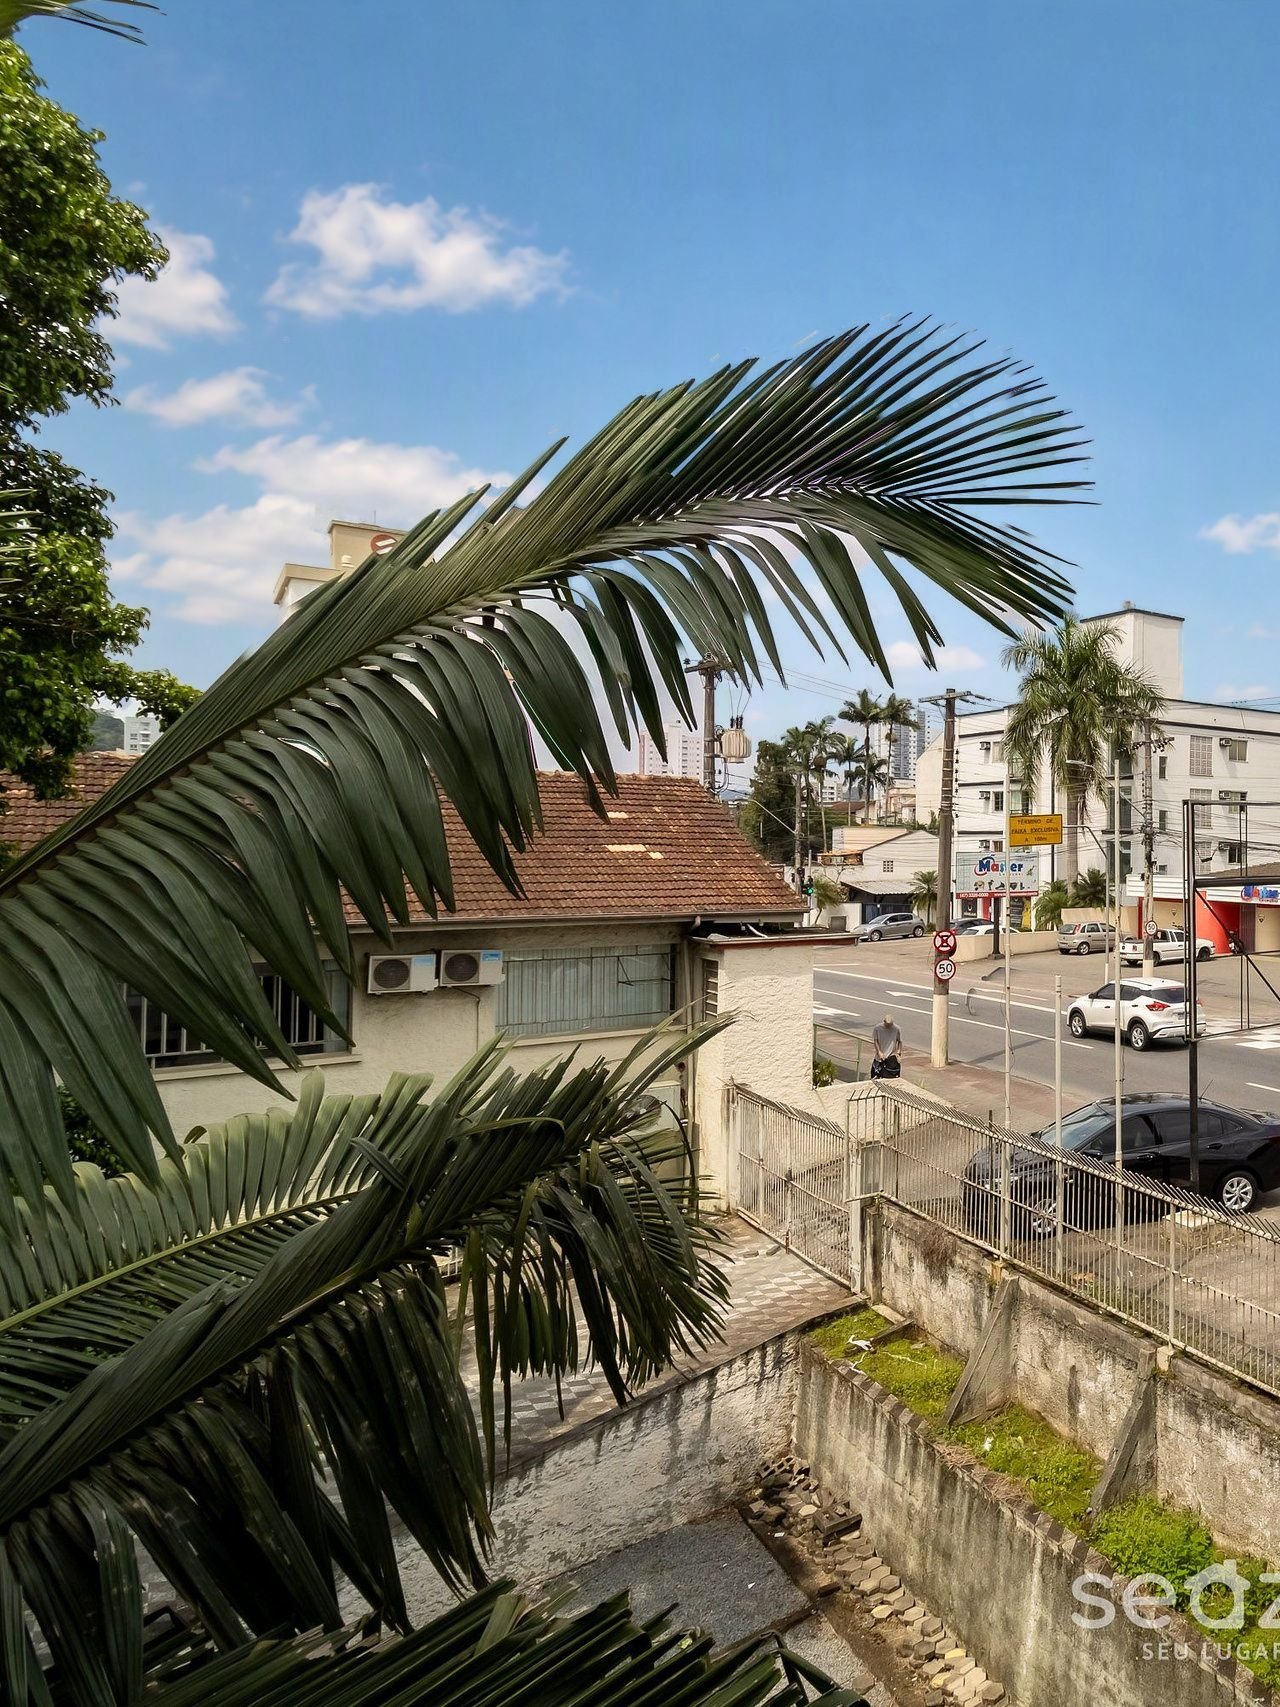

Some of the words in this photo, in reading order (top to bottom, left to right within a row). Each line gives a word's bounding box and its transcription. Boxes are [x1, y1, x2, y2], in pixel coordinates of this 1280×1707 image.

[978, 859, 1023, 873] Maser
[1148, 923, 1156, 931] 50
[939, 963, 953, 974] 50
